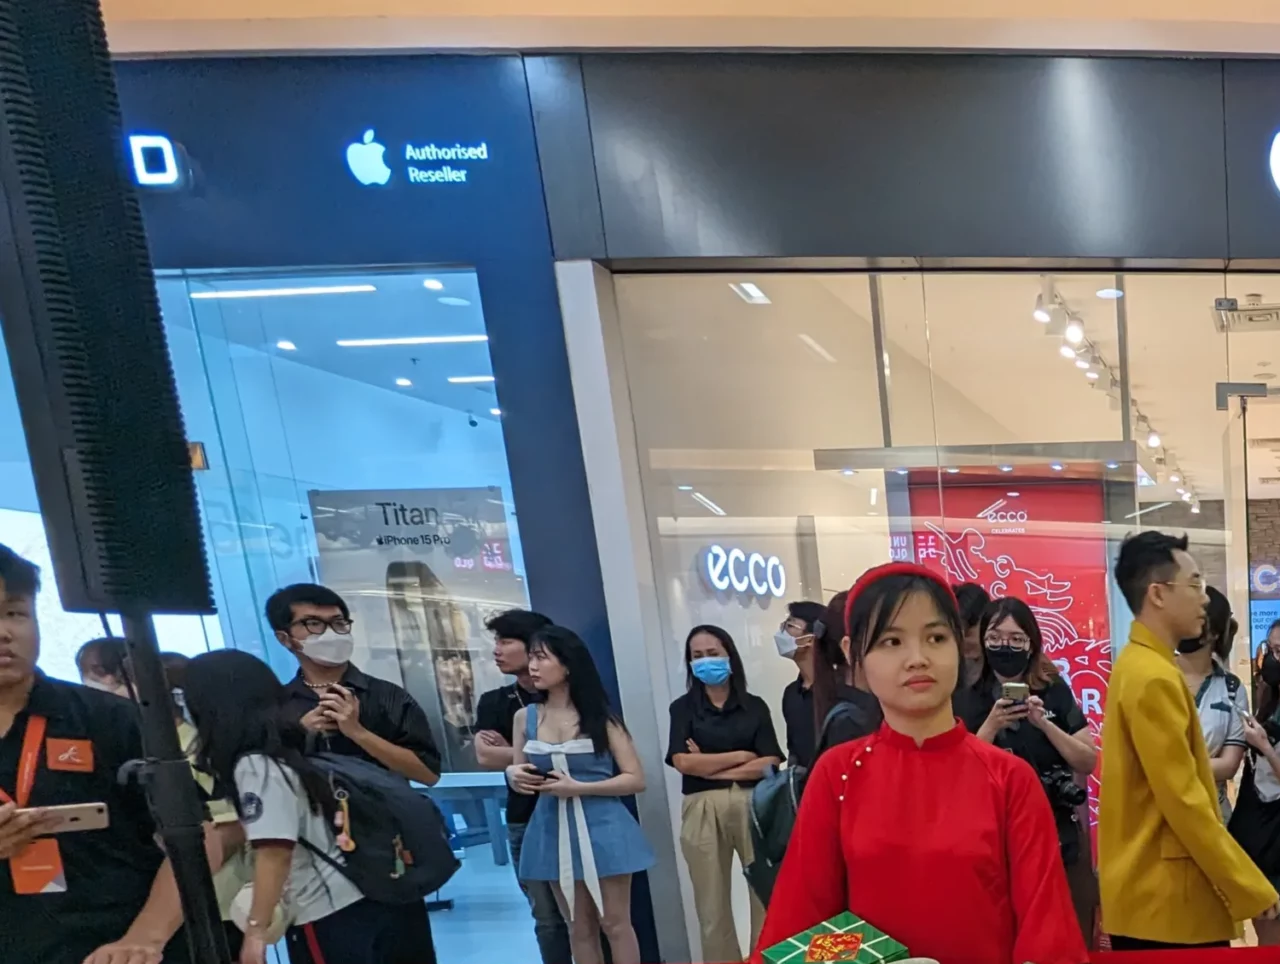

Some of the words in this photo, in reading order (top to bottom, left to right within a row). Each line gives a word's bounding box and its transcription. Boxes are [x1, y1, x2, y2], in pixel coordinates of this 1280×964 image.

[405, 142, 488, 160] Authorised
[408, 166, 467, 183] Reseller
[375, 502, 438, 526] Titan
[988, 511, 1028, 523] ecco
[384, 535, 419, 545] iPhone
[421, 535, 432, 545] 15
[707, 545, 786, 597] ecco
